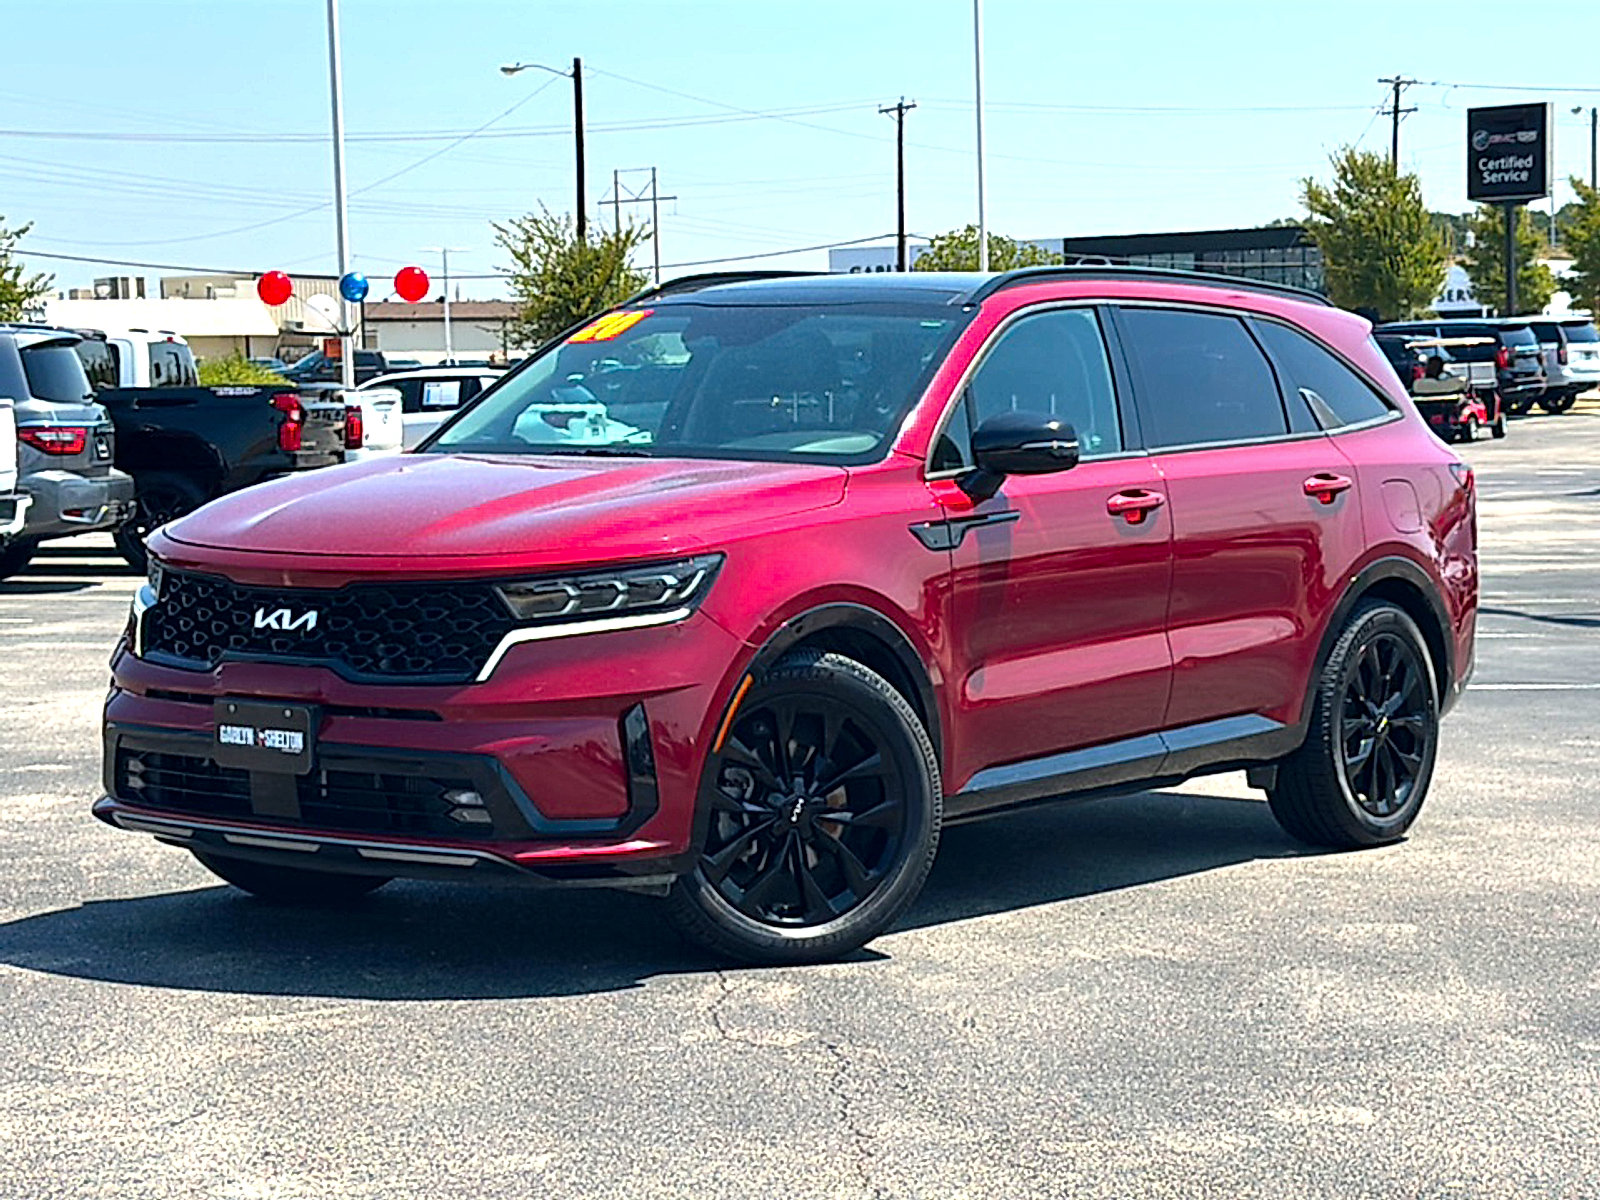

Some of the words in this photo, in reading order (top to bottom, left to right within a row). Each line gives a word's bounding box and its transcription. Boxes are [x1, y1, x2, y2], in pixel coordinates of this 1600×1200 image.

[1478, 154, 1533, 170] Certified
[1482, 170, 1529, 184] Service
[254, 607, 318, 632] KIA
